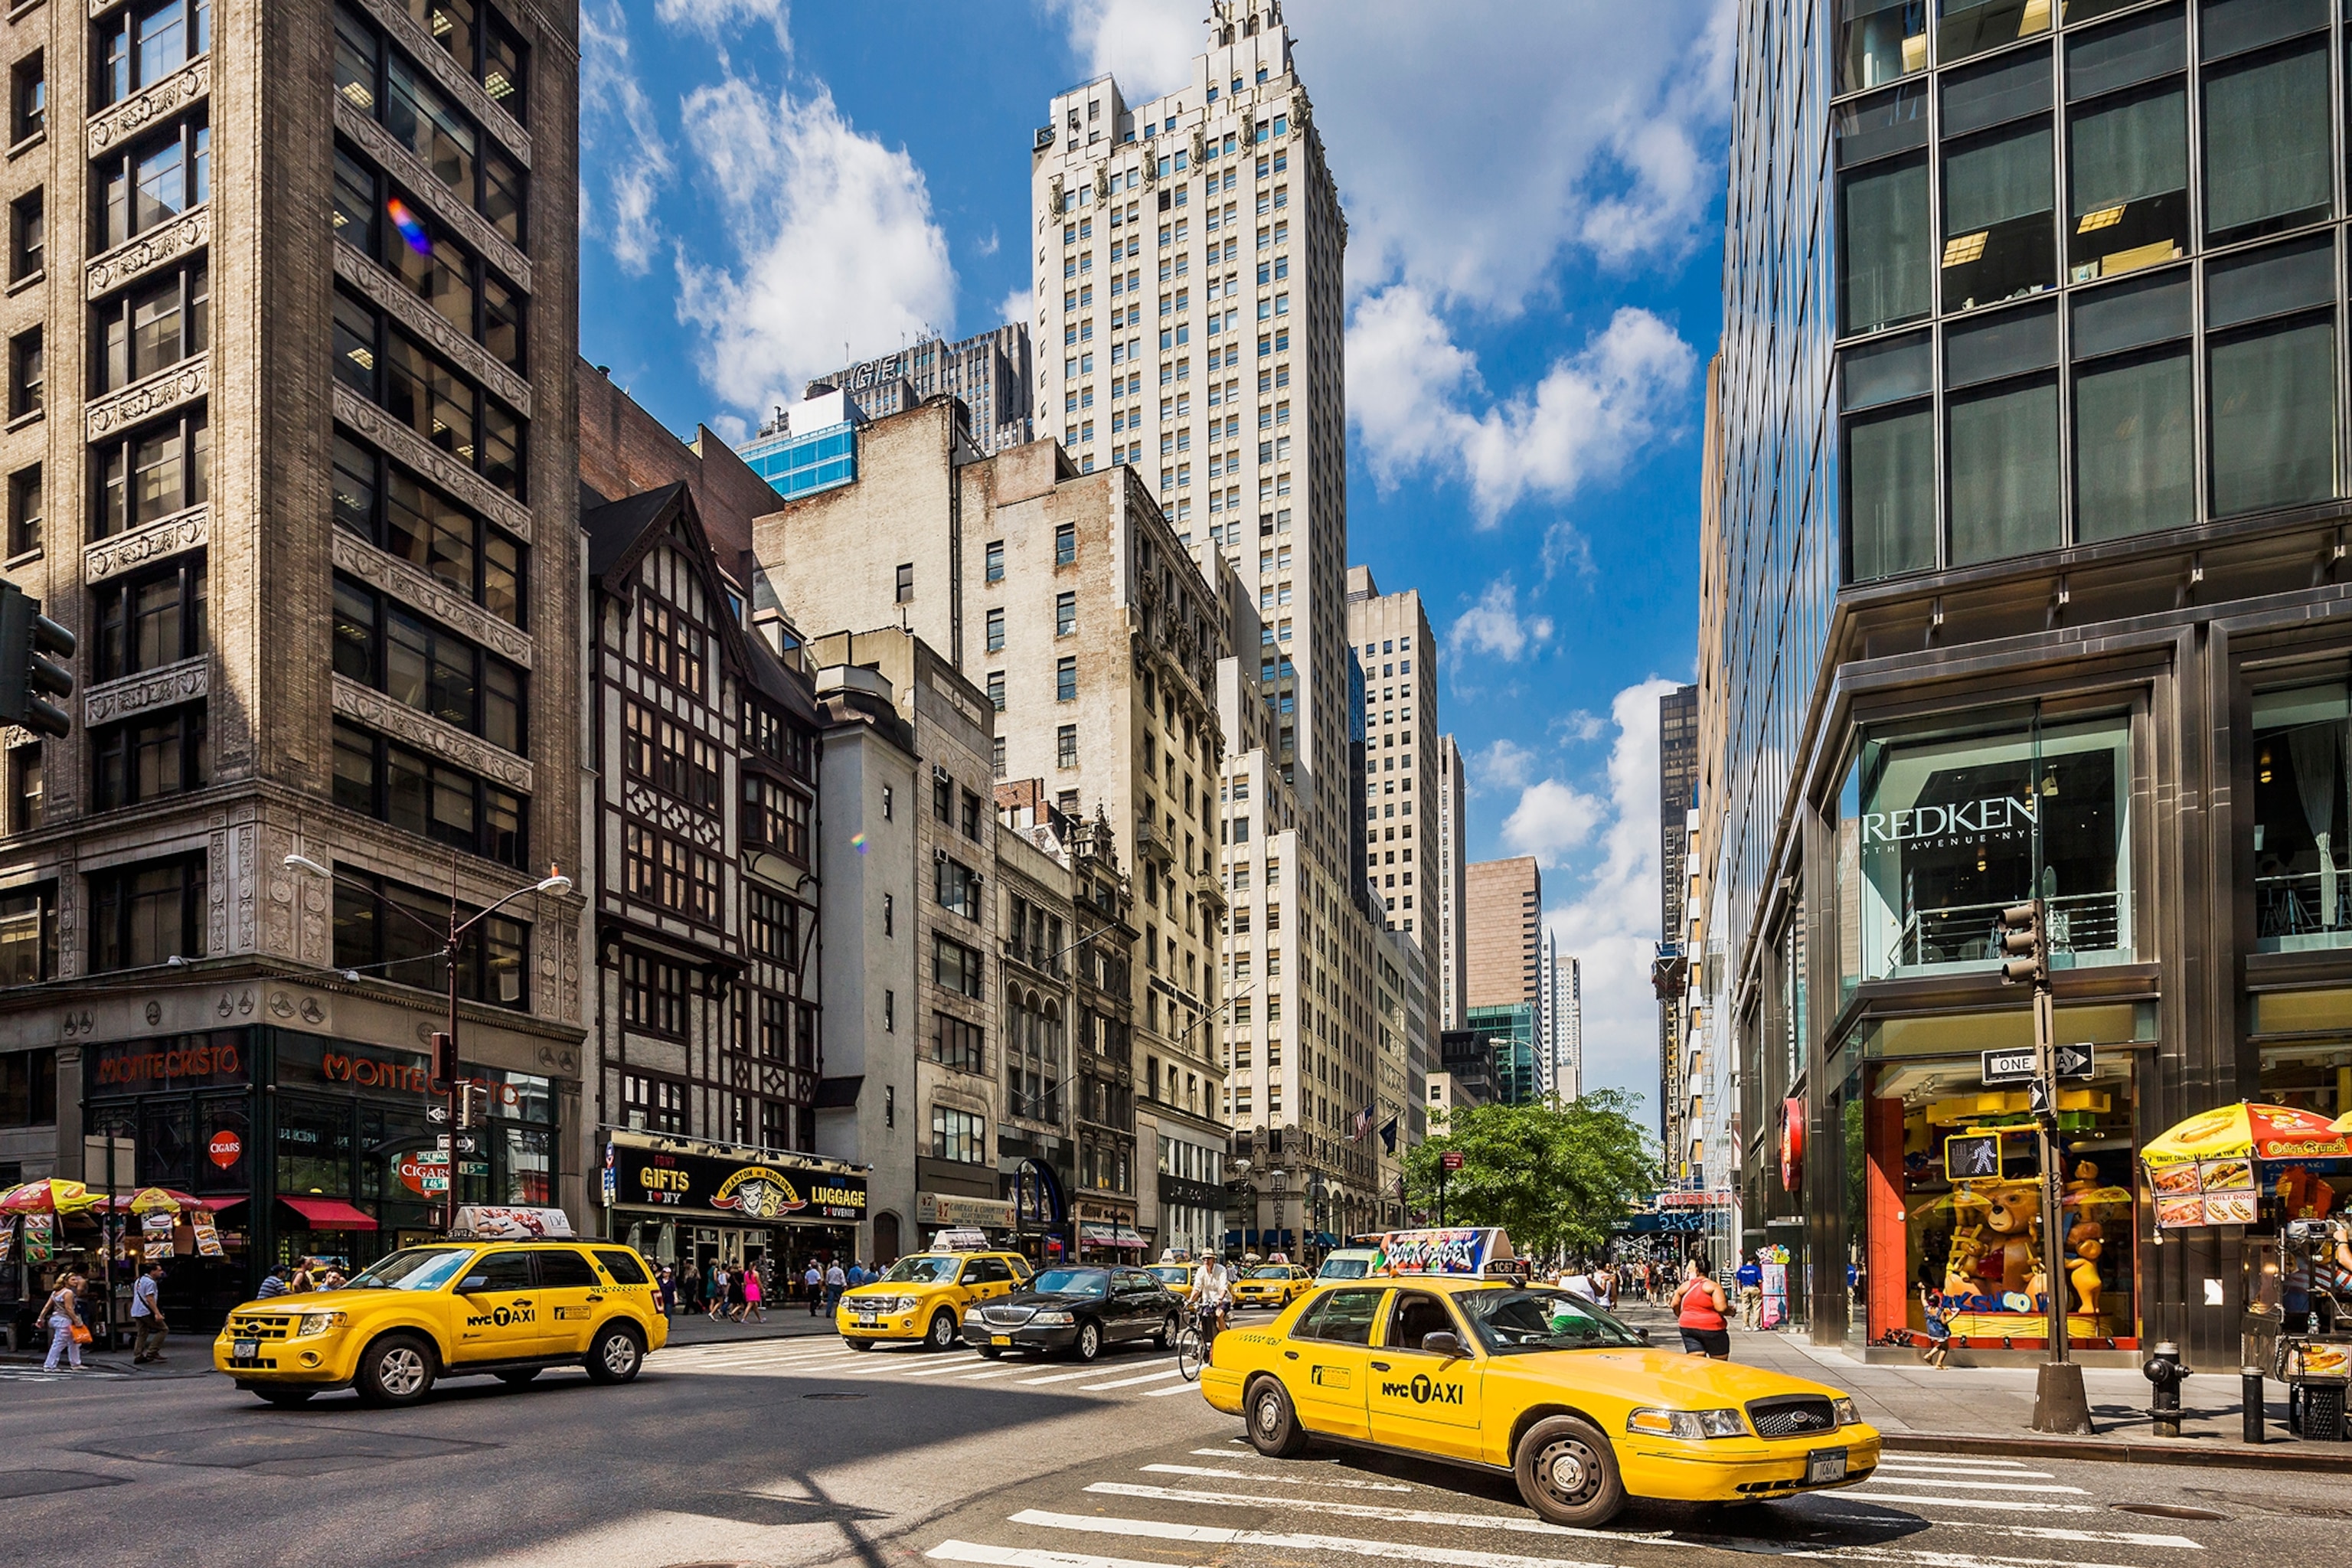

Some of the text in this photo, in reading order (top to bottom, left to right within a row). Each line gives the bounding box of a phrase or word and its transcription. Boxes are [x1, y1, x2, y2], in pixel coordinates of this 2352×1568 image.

[850, 352, 897, 393] GE
[1862, 793, 2039, 844] REDKEN
[1863, 828, 2039, 855] 5TH AVENUE NYC
[100, 1045, 239, 1083] MONTECRISTO
[2000, 1054, 2076, 1070] ONE AY
[323, 1054, 520, 1106] MONTECSTO
[210, 1142, 240, 1153] CIGARS
[2303, 1138, 2347, 1155] Crunch
[469, 1165, 476, 1174] 5
[640, 1167, 690, 1192] GIFTS
[766, 1170, 795, 1199] BROADWAY
[647, 1191, 681, 1204] I NY
[812, 1187, 866, 1207] LUGGAGE
[921, 1196, 933, 1207] 47
[1664, 1194, 1713, 1205] GUESS
[937, 1201, 949, 1217] 47
[1005, 1208, 1014, 1222] 47
[1435, 1233, 1449, 1241] BEST
[1381, 1239, 1428, 1269] ROCK
[1428, 1236, 1481, 1271] AGES
[1494, 1262, 1514, 1272] 1C67
[467, 1308, 535, 1326] NYC TAXI
[1266, 1335, 1282, 1346] 1C67
[1382, 1376, 1463, 1404] NYC TAXI
